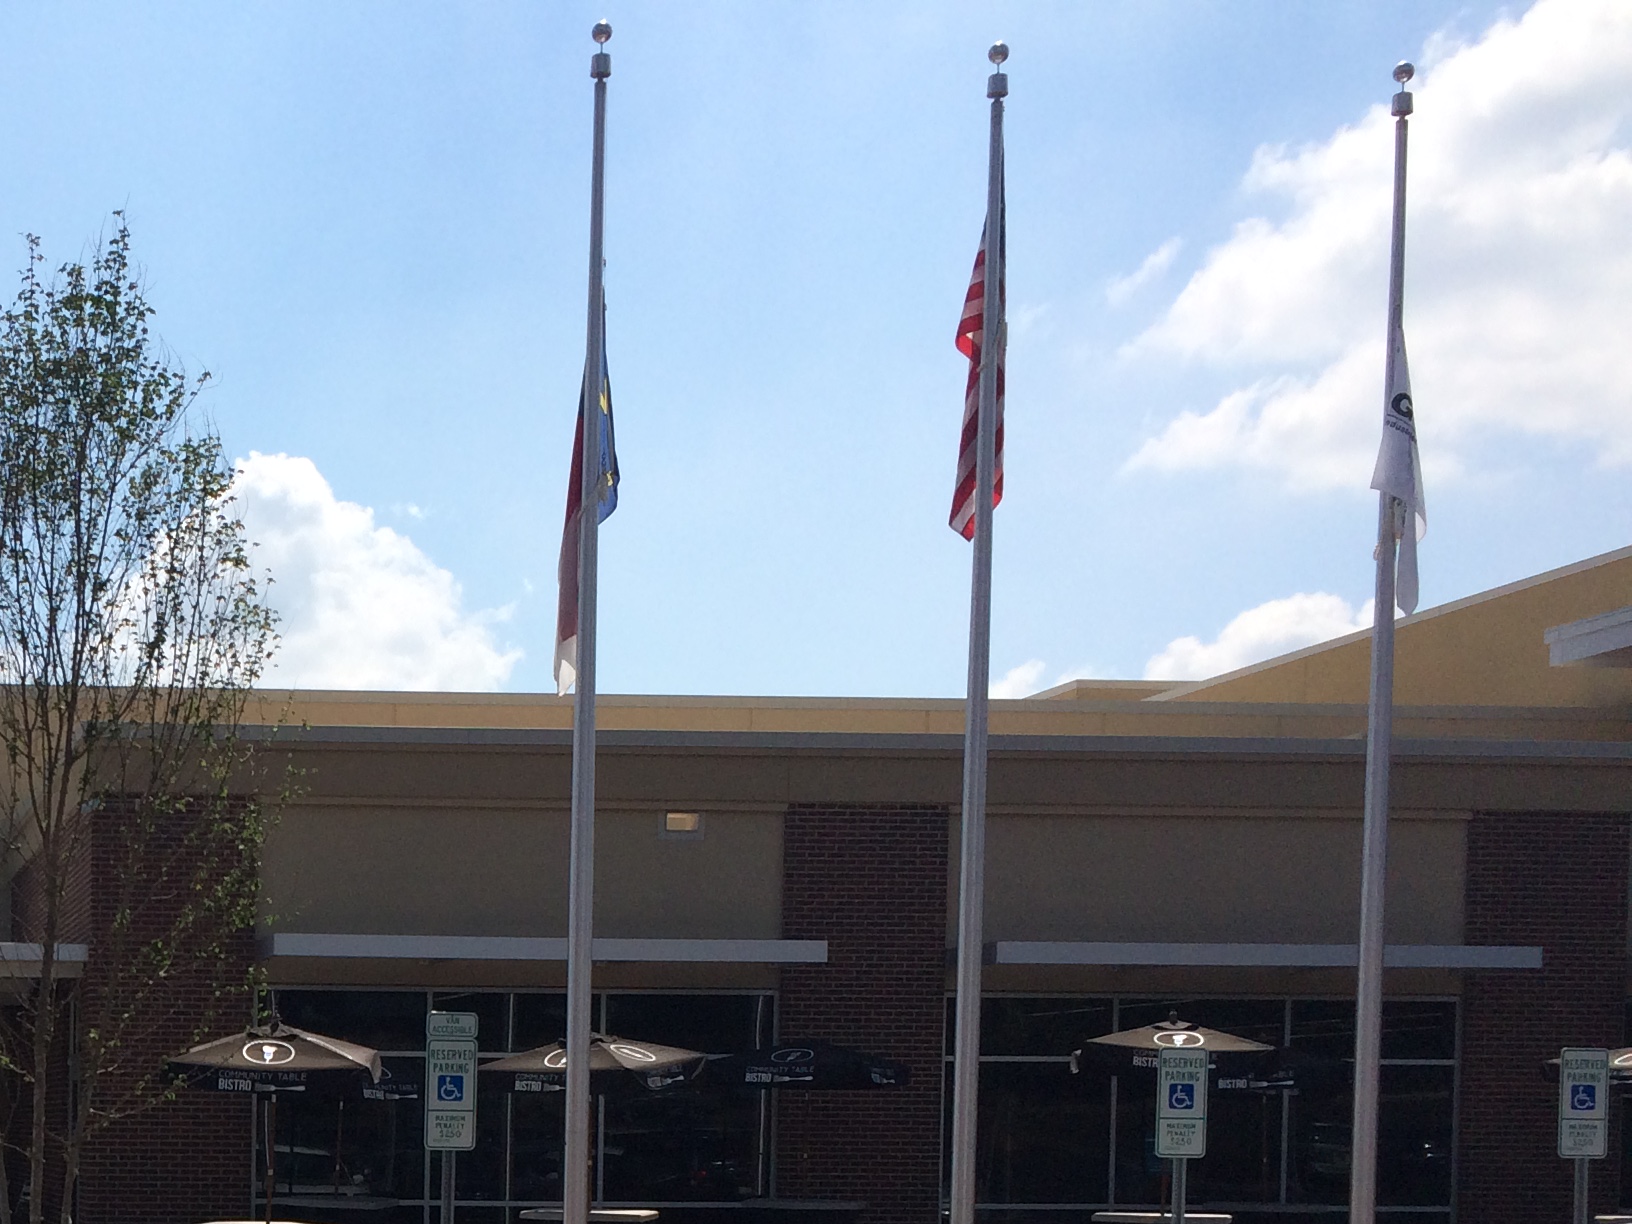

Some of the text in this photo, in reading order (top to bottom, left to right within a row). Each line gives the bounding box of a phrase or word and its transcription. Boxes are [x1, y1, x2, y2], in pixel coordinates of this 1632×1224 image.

[445, 1017, 460, 1025] VAN
[430, 1049, 474, 1060] RESERVED
[1132, 1056, 1158, 1068] BISTR
[1162, 1057, 1205, 1069] RESERVED
[433, 1062, 469, 1074] PARKING
[218, 1069, 307, 1081] COMMUNITY TABLE
[745, 1072, 772, 1083] BISTRO
[1165, 1071, 1200, 1082] PARKING
[218, 1078, 252, 1091] BISTRO
[515, 1081, 542, 1092] BISTRO
[1218, 1078, 1247, 1088] BISTRO
